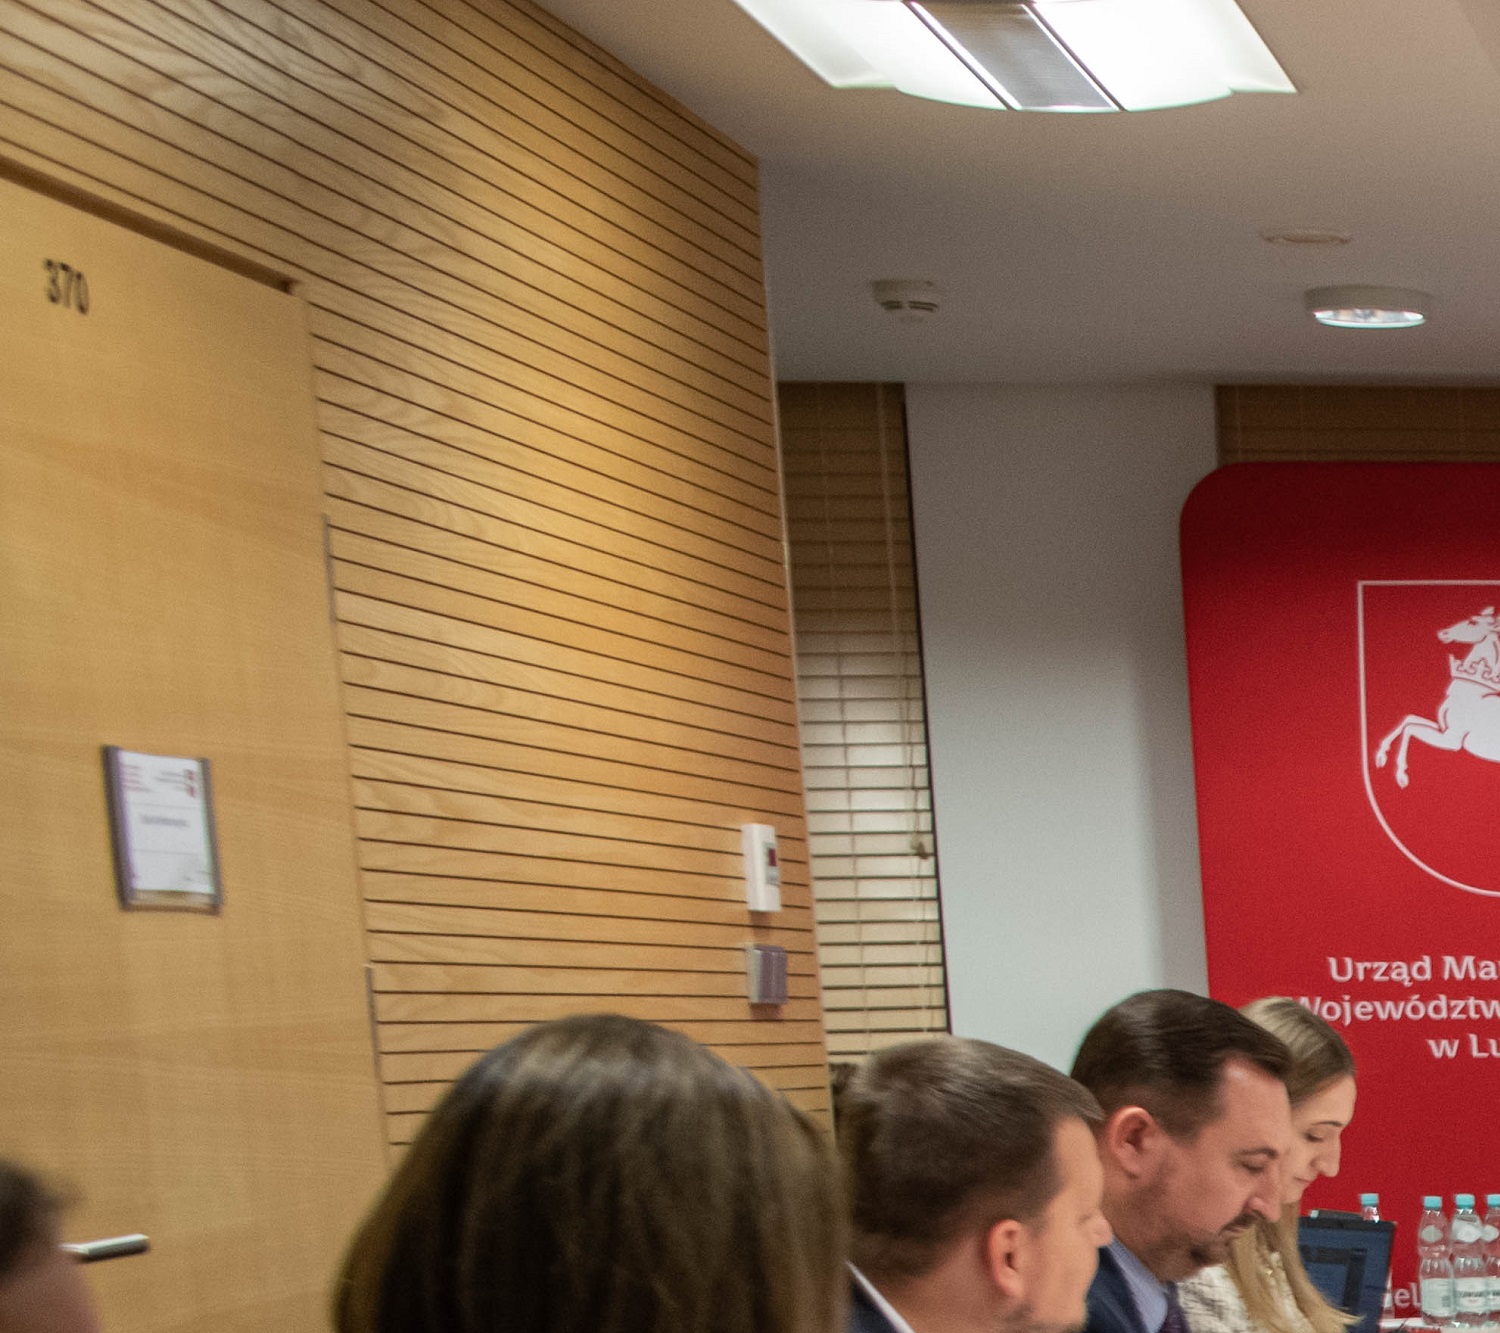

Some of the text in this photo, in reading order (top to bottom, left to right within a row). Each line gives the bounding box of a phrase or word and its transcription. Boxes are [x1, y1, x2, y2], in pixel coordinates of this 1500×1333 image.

[42, 257, 90, 315] 370
[1327, 955, 1432, 987] Urząd
[1428, 1039, 1459, 1059] w
